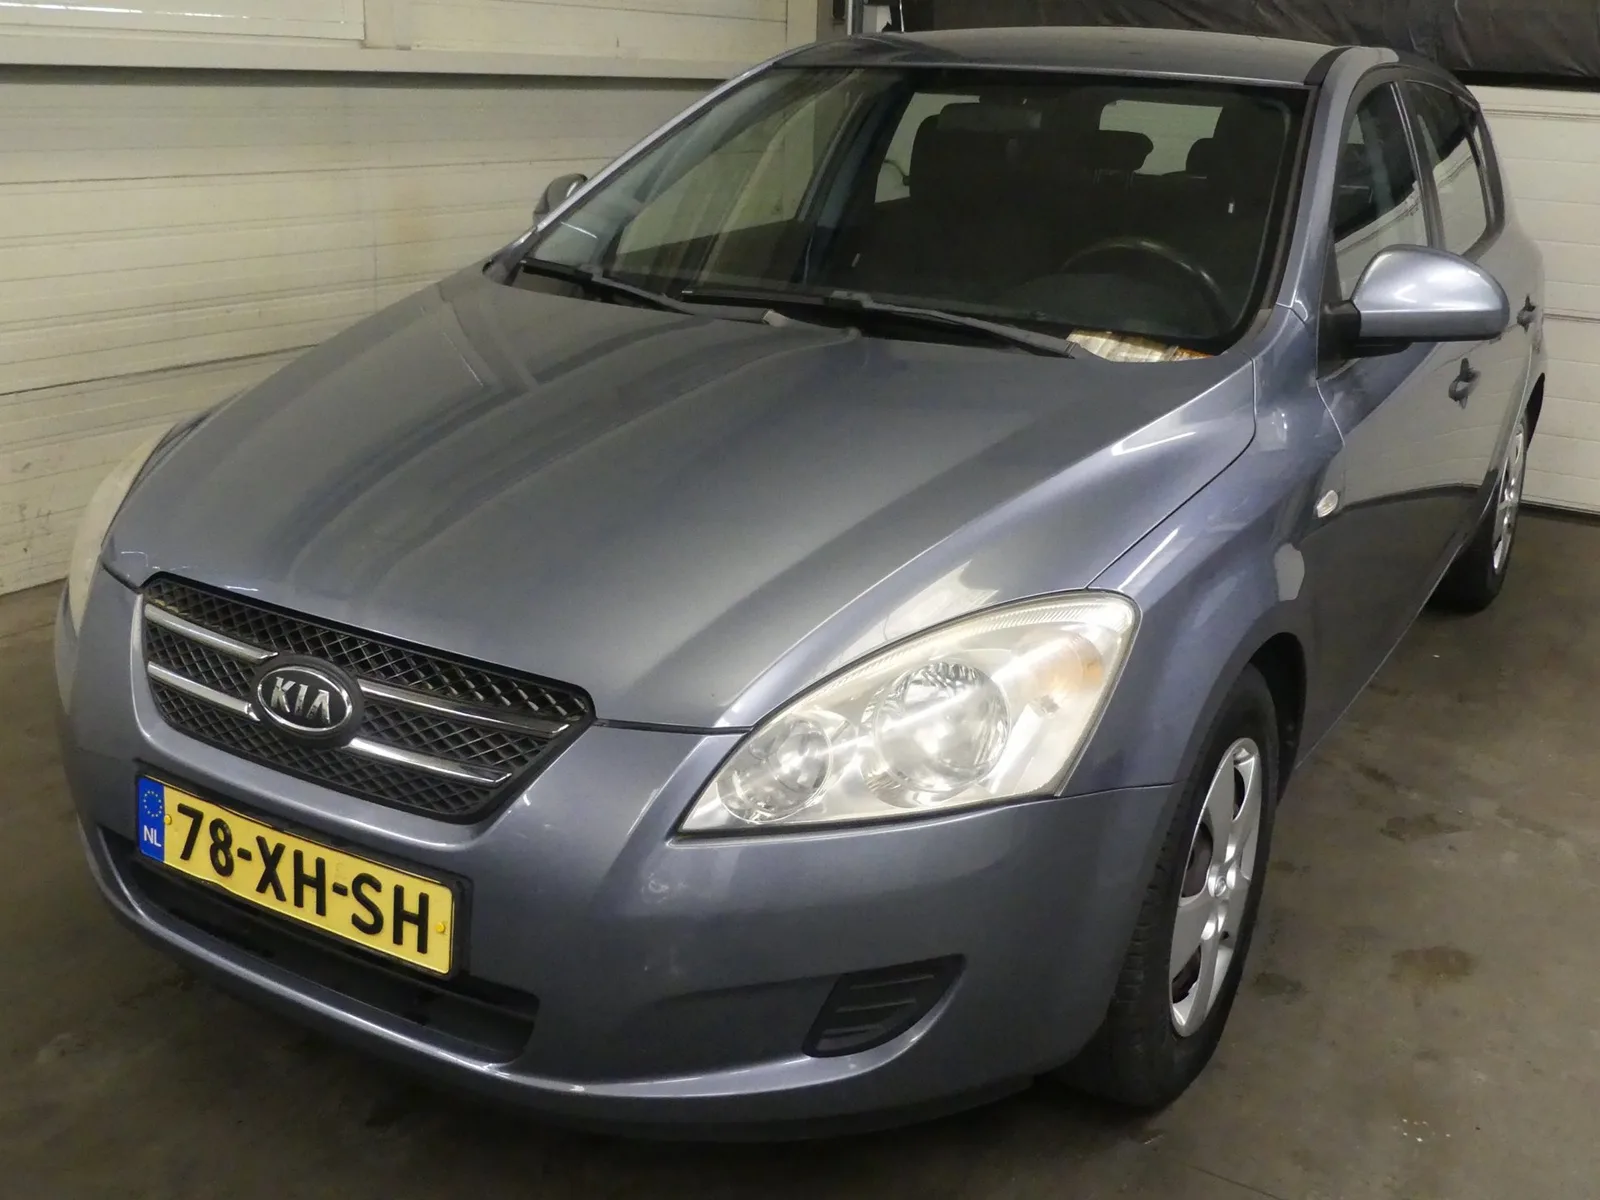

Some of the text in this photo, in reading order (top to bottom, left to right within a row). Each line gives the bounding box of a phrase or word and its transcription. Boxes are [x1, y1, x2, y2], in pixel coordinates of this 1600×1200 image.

[271, 676, 331, 724] KIA
[143, 826, 162, 848] NL
[177, 803, 429, 955] 78-XH-SH
